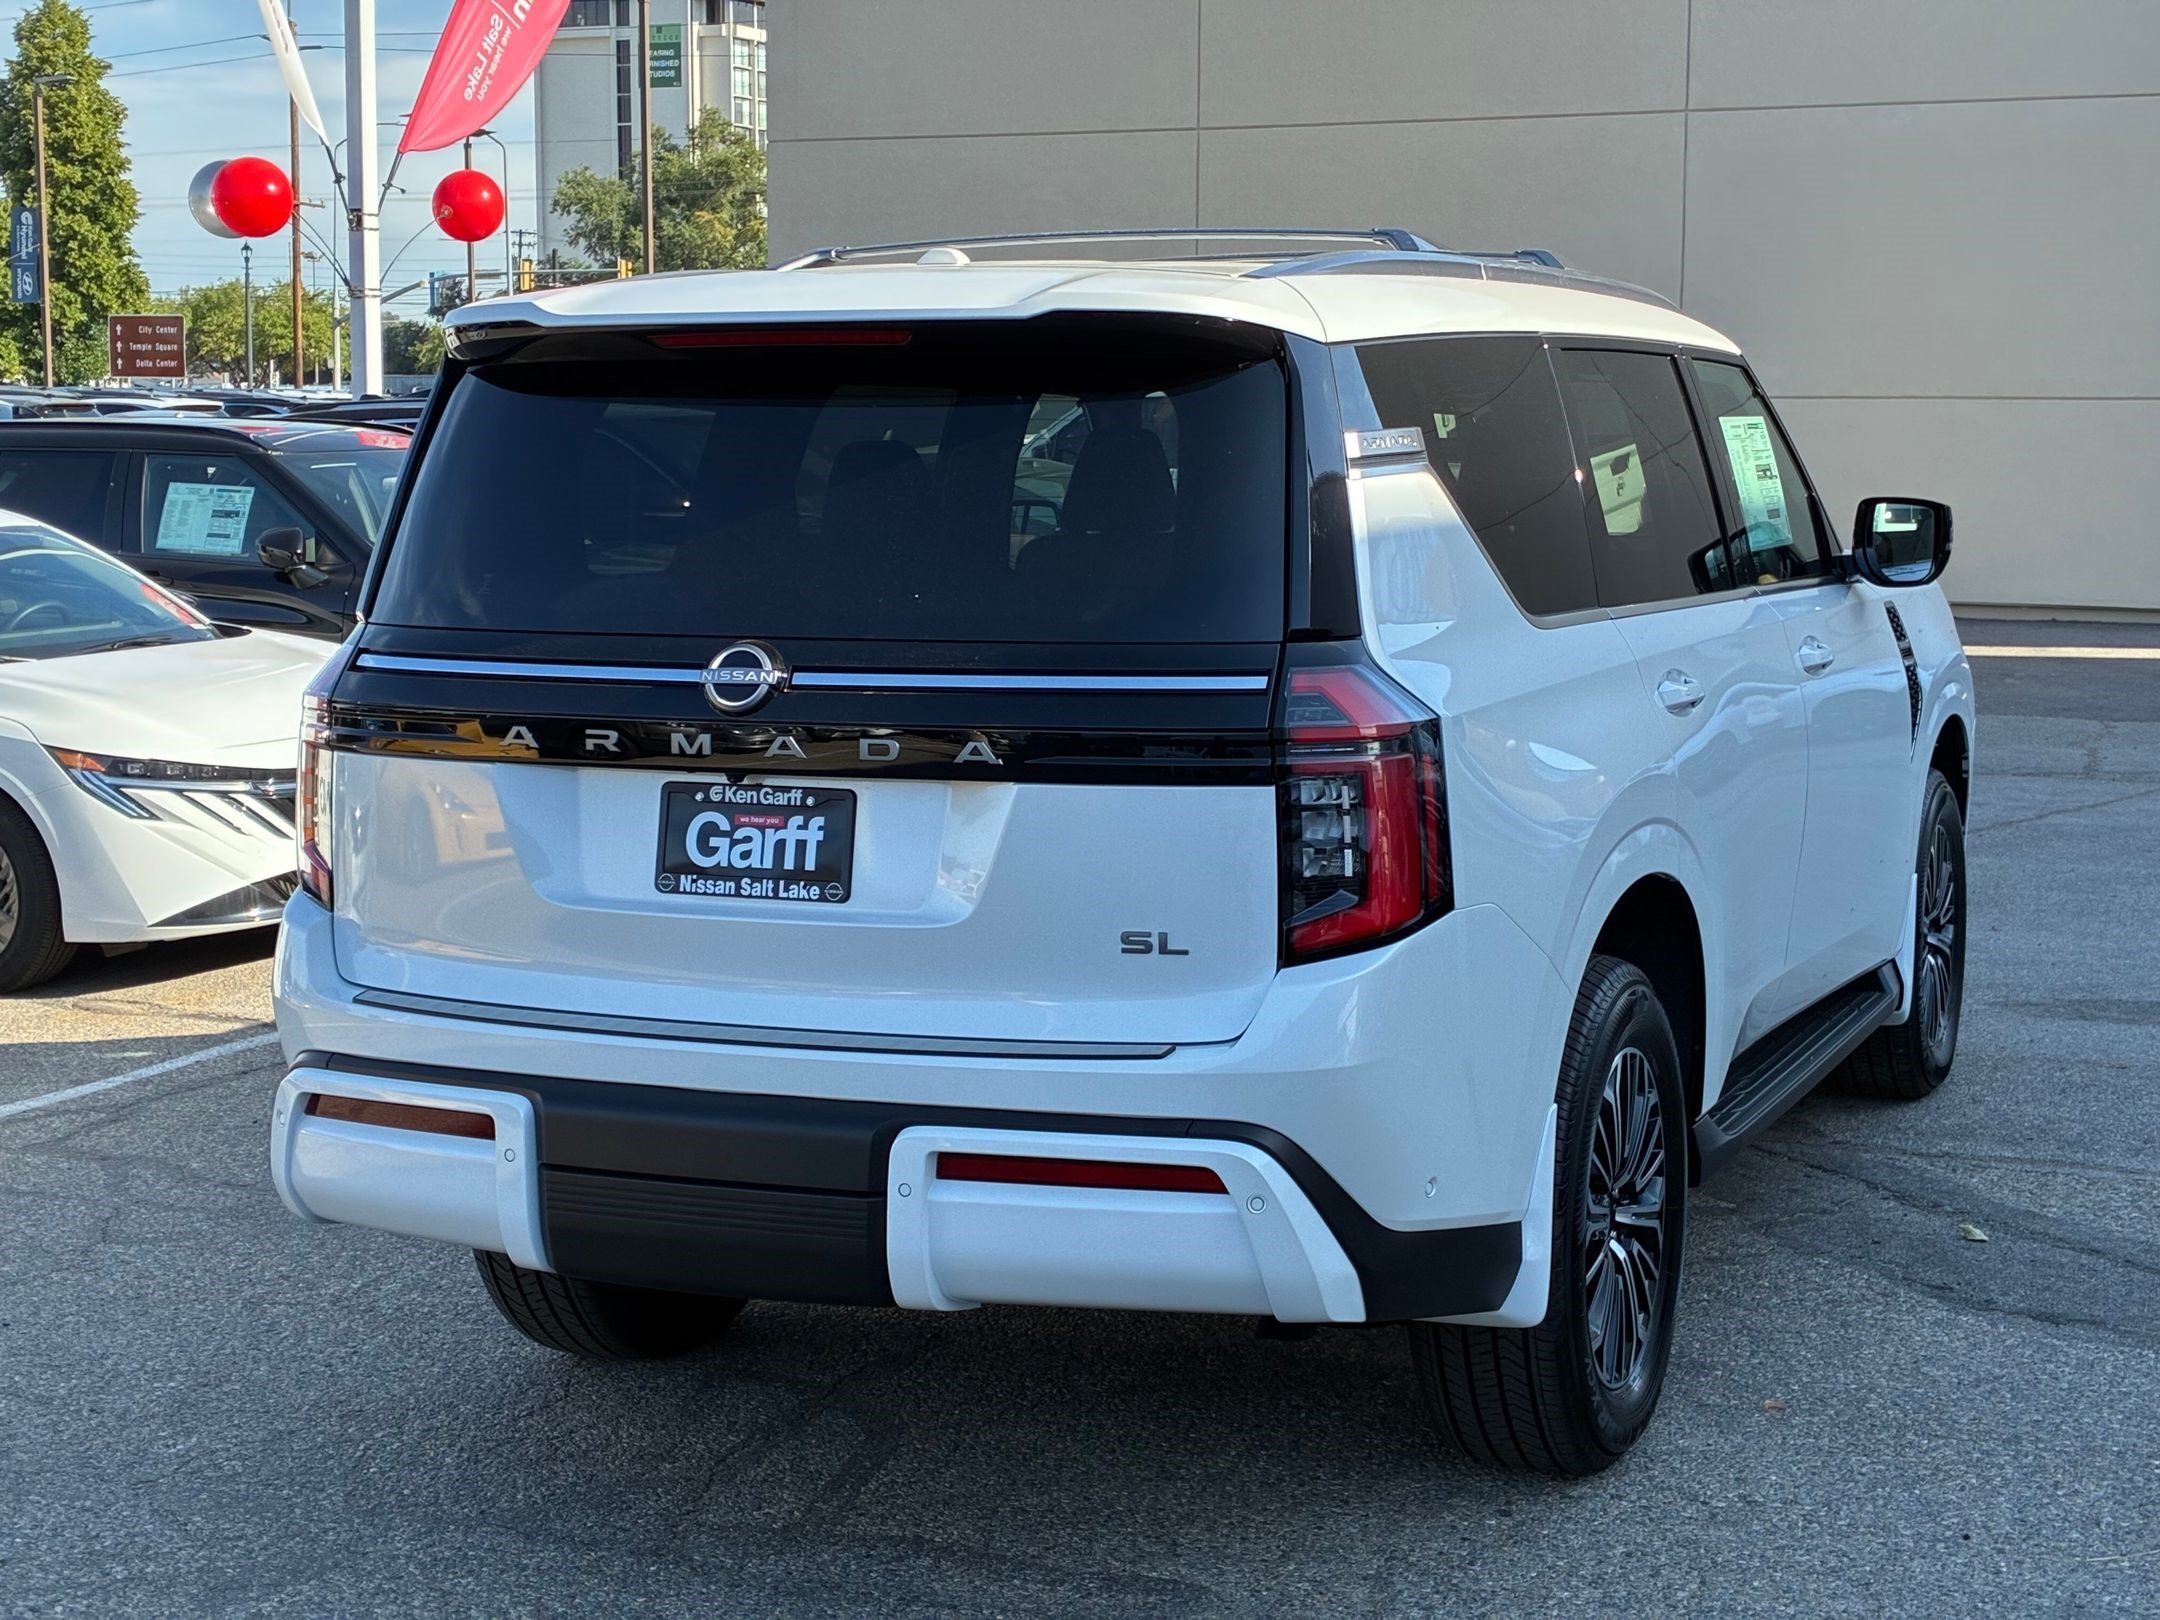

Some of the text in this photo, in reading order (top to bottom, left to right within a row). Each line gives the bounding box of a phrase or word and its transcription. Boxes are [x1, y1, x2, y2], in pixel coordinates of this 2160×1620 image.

[649, 70, 676, 78] TUDIOS
[138, 325, 178, 335] City Center
[129, 342, 178, 352] Temple Square
[136, 359, 178, 368] Delta Center
[702, 670, 774, 682] NISSAN
[501, 725, 1004, 766] ARMADA
[725, 786, 803, 806] Ken Garff
[766, 817, 779, 825] you
[685, 811, 825, 871] Garff
[679, 874, 820, 900] Nissan Salt Lake
[1120, 931, 1189, 956] SL
